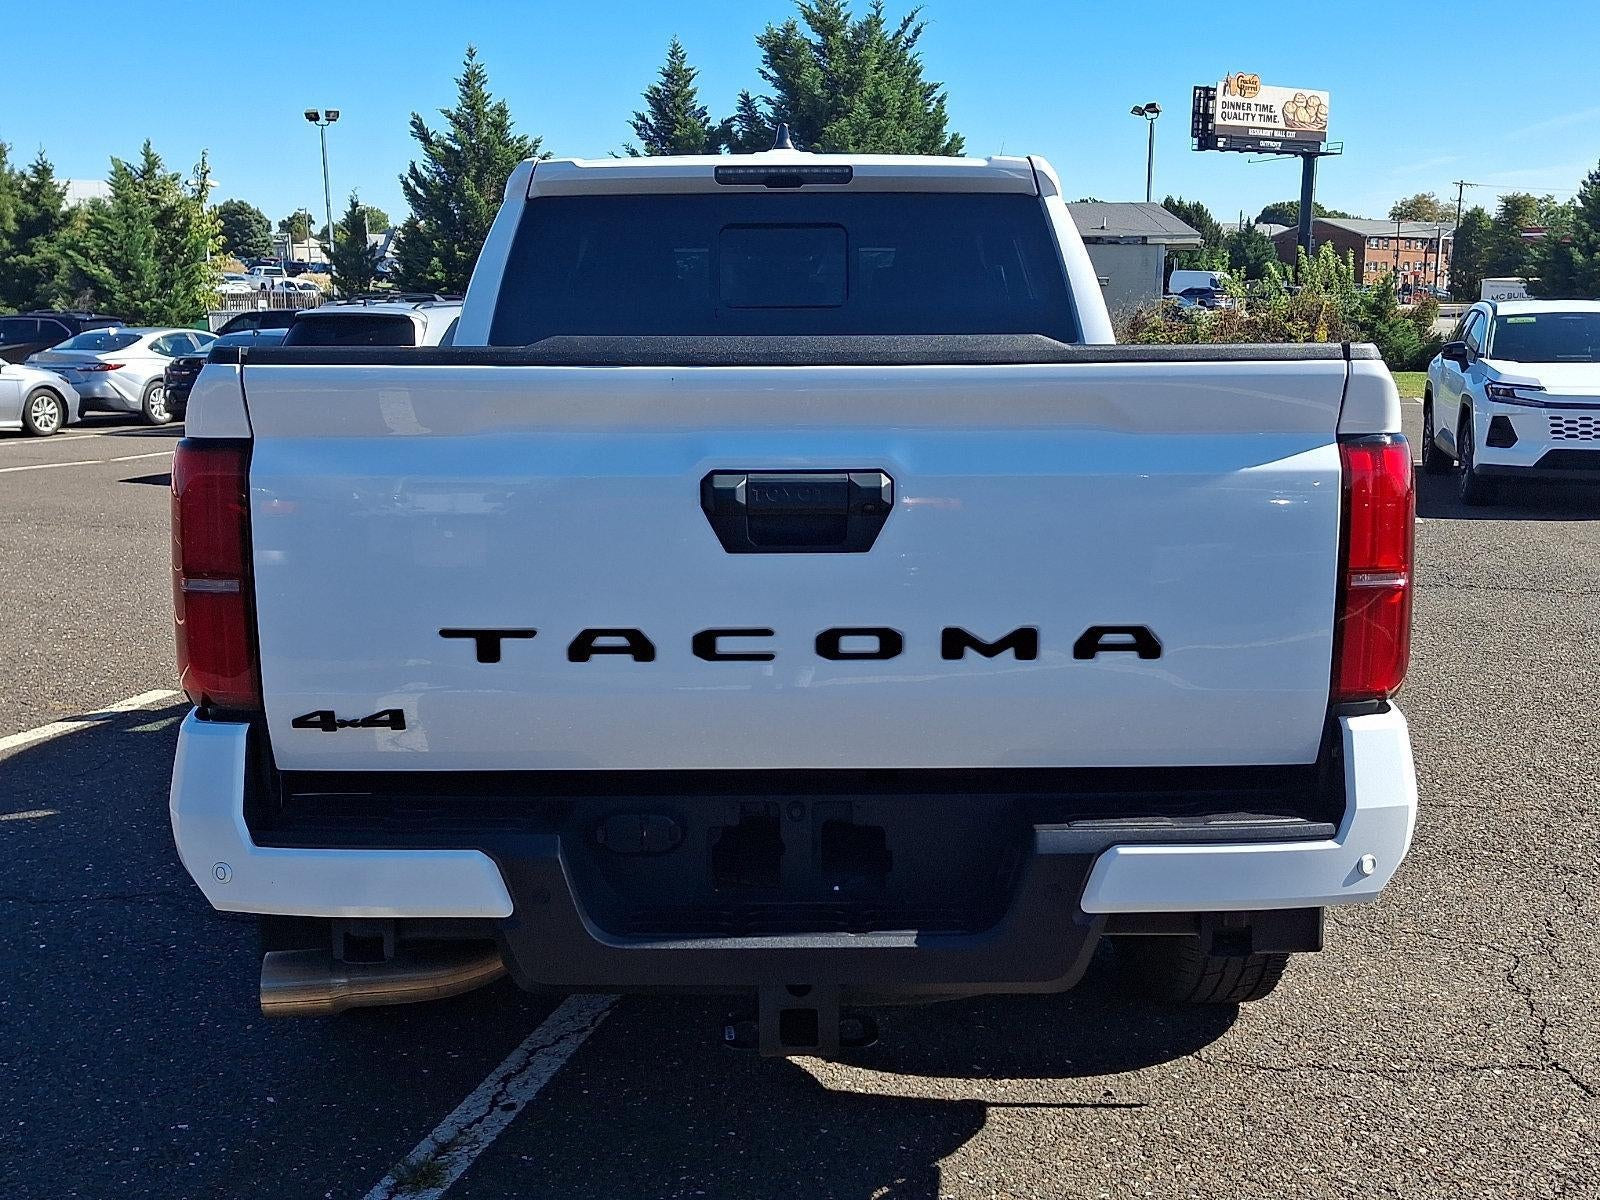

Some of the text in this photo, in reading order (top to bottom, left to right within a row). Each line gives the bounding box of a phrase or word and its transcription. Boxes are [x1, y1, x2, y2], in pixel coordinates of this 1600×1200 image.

[1236, 75, 1258, 89] Cracker
[1240, 84, 1258, 97] Barrel
[1221, 101, 1276, 113] DINNER TIME.
[1220, 111, 1280, 123] QUALITY TIME.
[438, 625, 1163, 664] TACOMA
[291, 708, 407, 732] 4x4
